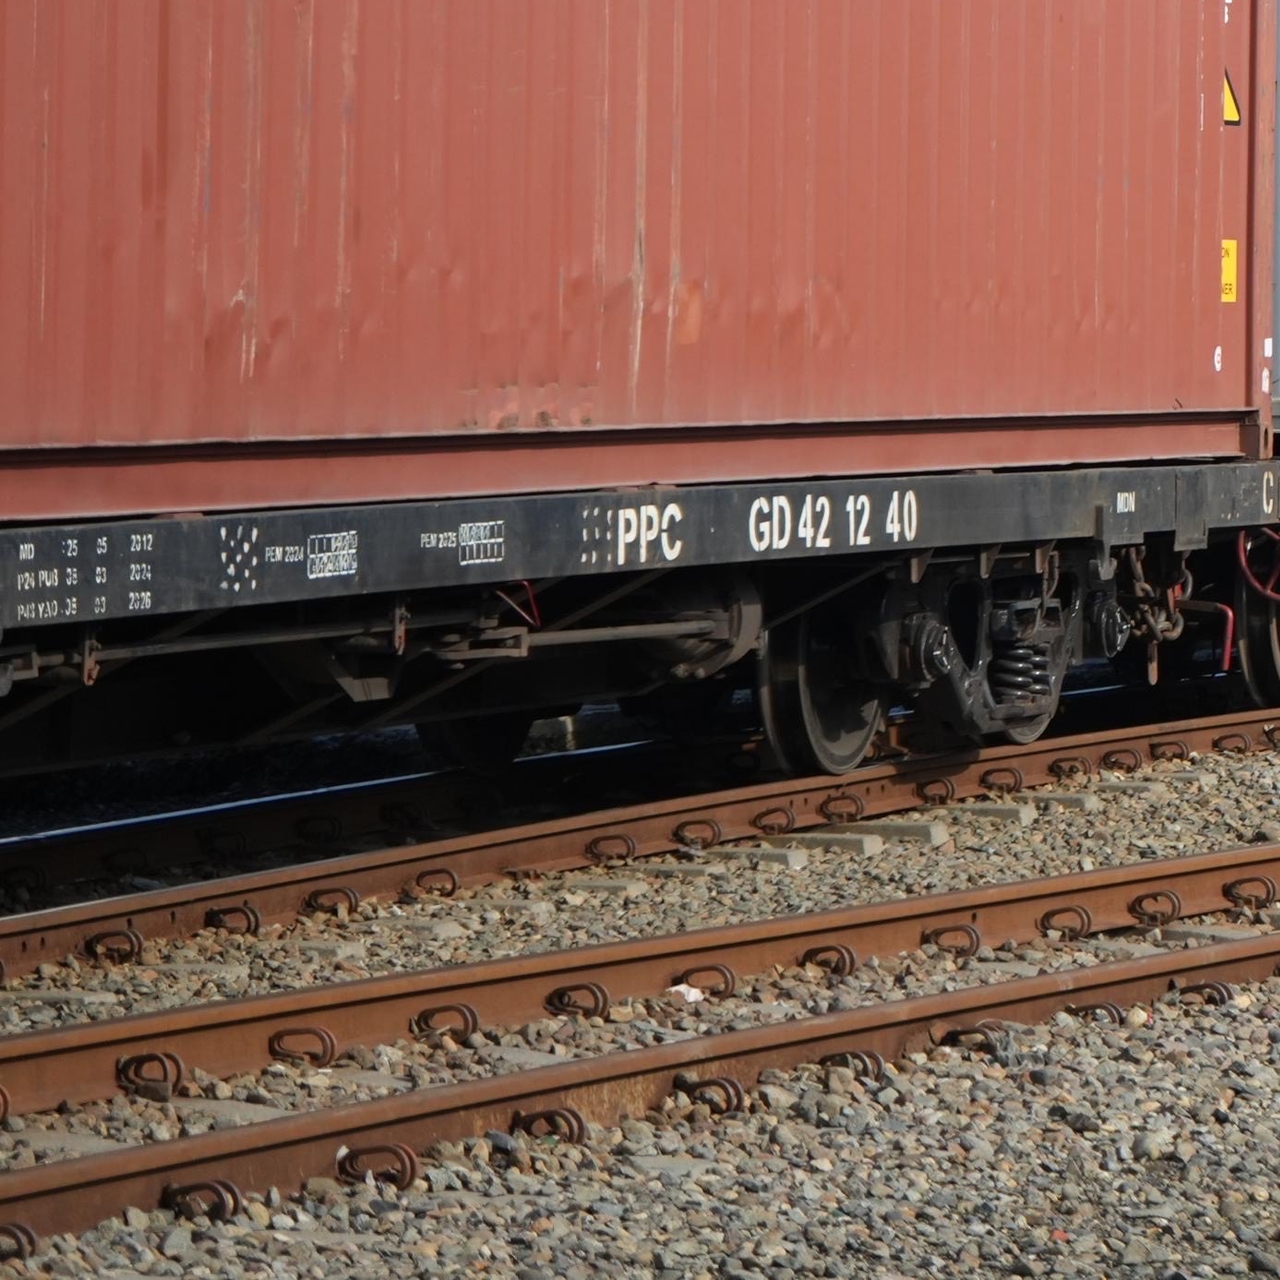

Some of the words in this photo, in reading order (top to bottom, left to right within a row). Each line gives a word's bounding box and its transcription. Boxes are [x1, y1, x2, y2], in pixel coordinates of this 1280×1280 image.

[846, 494, 871, 546] 12
[886, 490, 918, 543] 40
[1262, 471, 1274, 515] C
[130, 534, 153, 552] 2012
[617, 503, 683, 566] PPC
